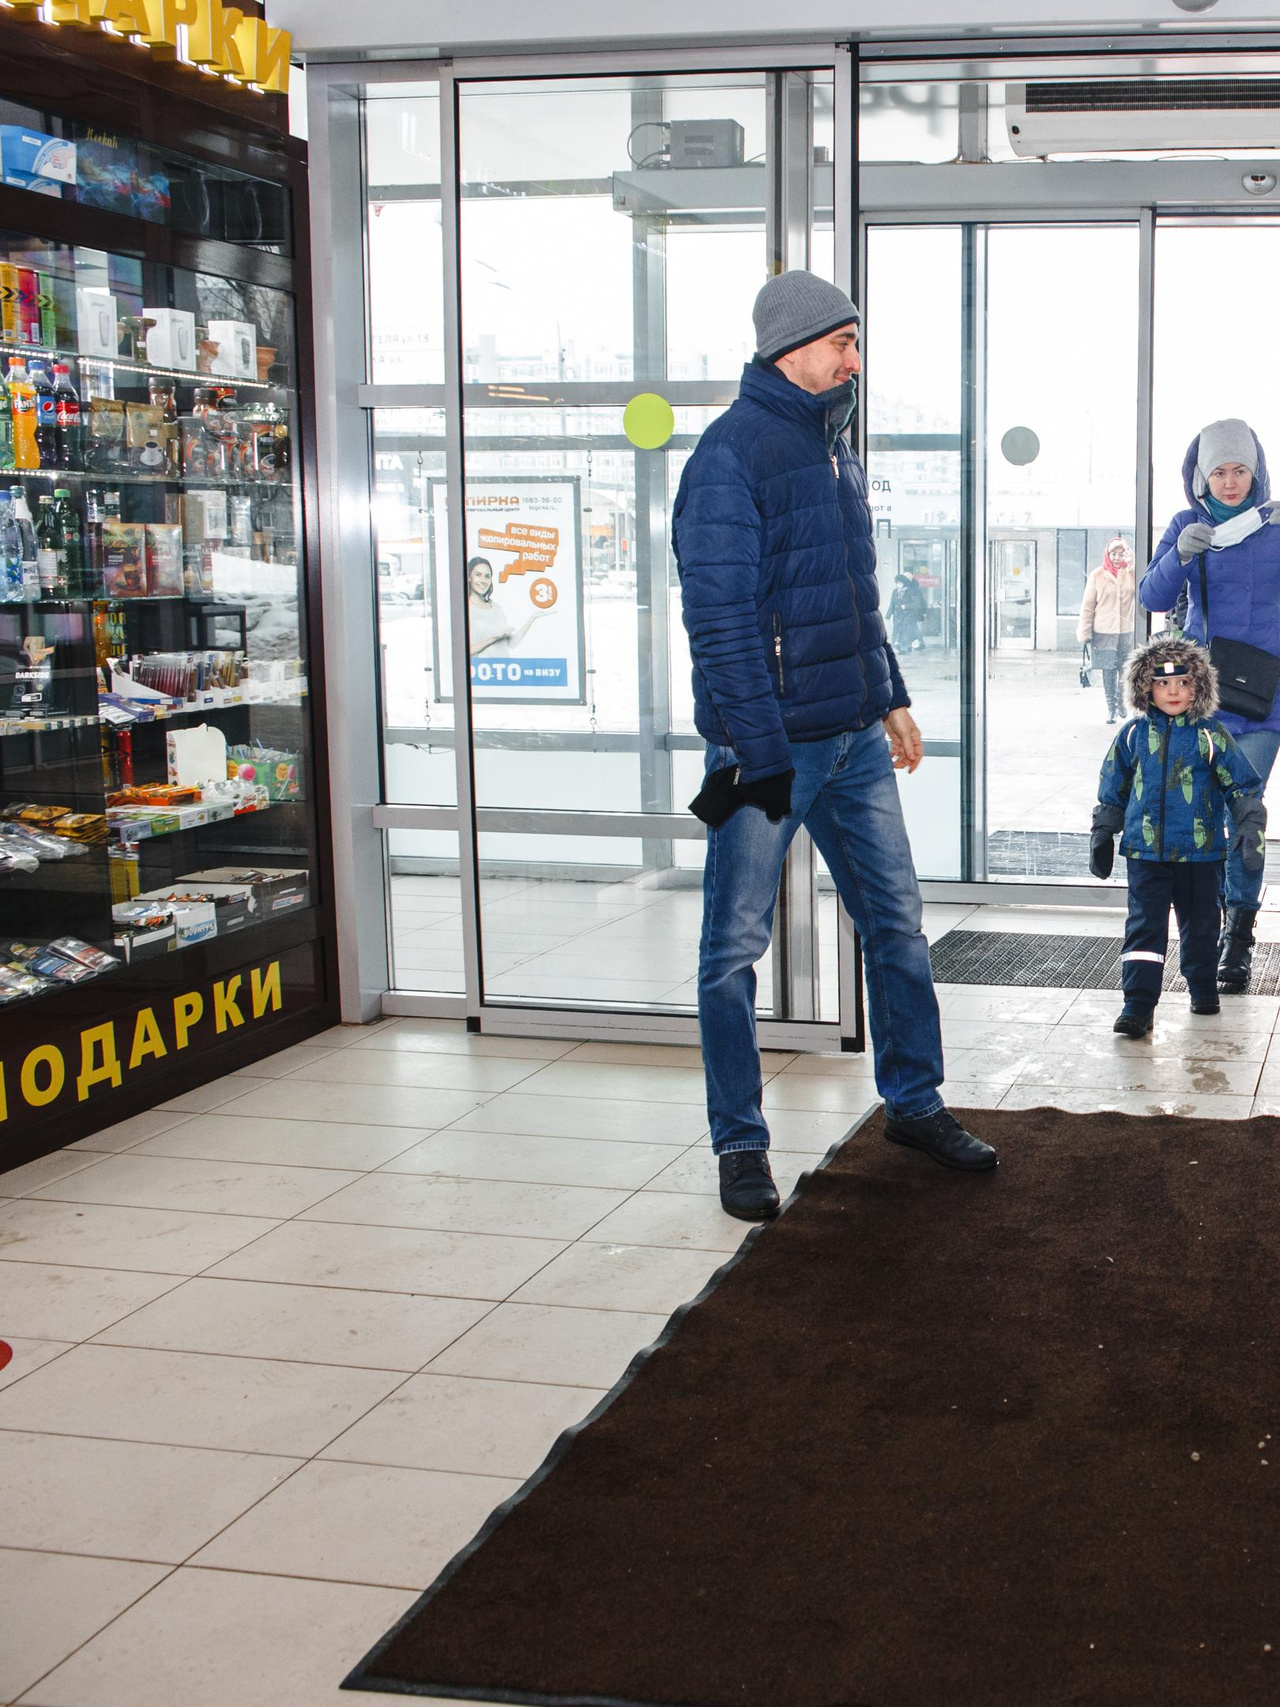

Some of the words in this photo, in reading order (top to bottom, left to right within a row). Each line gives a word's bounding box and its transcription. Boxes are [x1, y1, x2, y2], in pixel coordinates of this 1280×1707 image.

[511, 526, 528, 535] все
[529, 529, 555, 539] виды
[522, 552, 551, 562] работ
[535, 668, 561, 677] ВИЗУ
